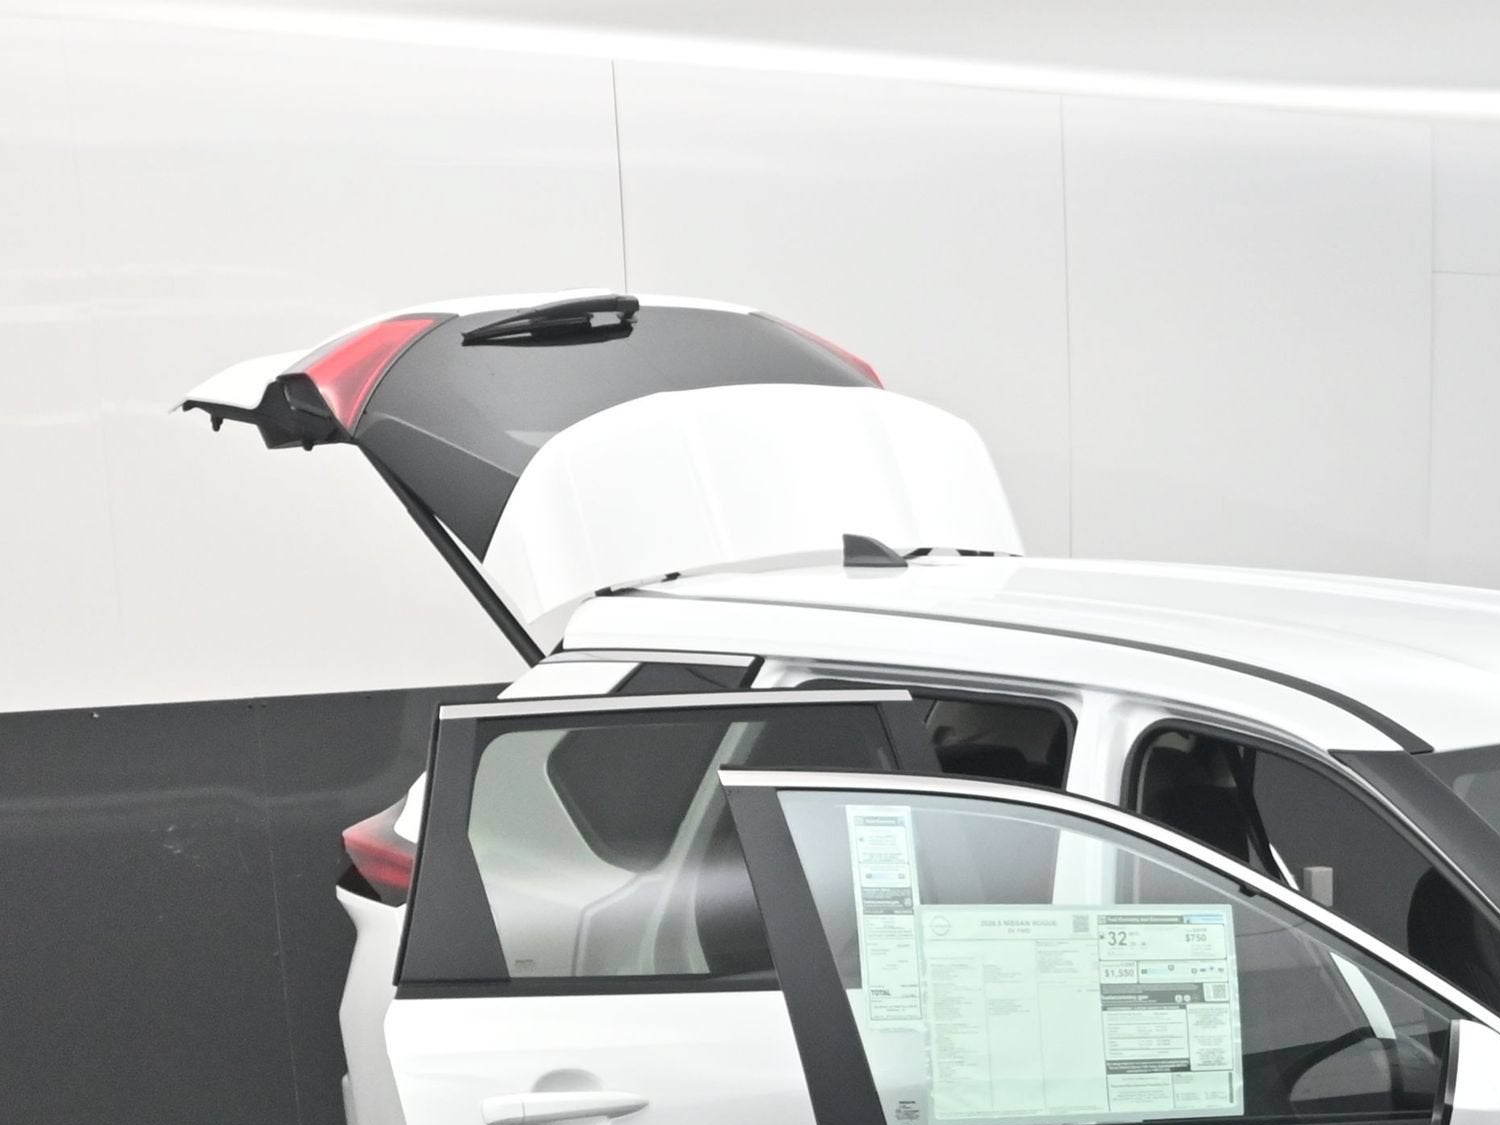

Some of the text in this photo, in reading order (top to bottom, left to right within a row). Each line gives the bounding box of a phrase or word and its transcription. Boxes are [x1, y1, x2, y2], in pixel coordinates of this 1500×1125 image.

[1107, 931, 1128, 946] 32
[1185, 934, 1207, 942] $750
[1104, 969, 1135, 978] $1,550
